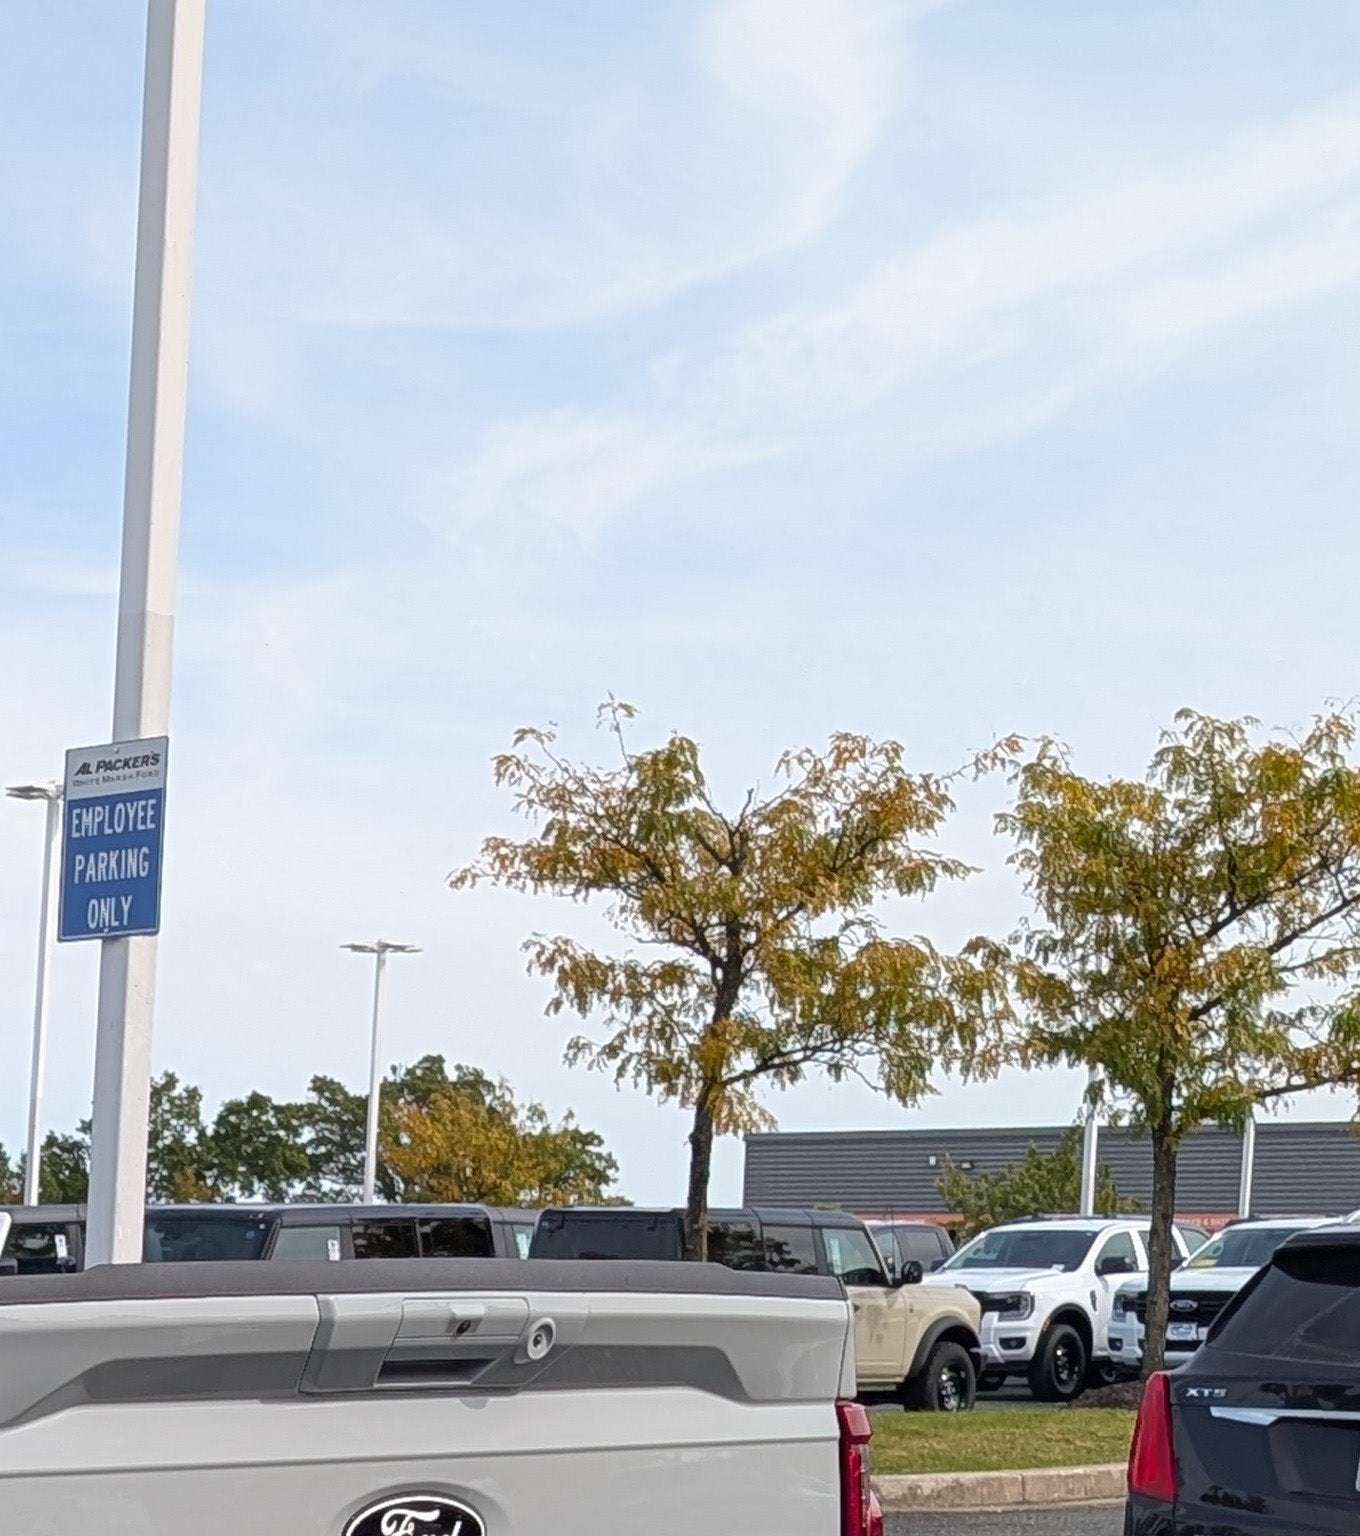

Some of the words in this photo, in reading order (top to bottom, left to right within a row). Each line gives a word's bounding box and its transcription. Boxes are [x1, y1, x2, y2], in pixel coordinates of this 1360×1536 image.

[74, 762, 93, 776] AL
[71, 799, 157, 838] EMPLOYEE
[74, 846, 150, 884] PARKING
[87, 895, 133, 929] ONLY
